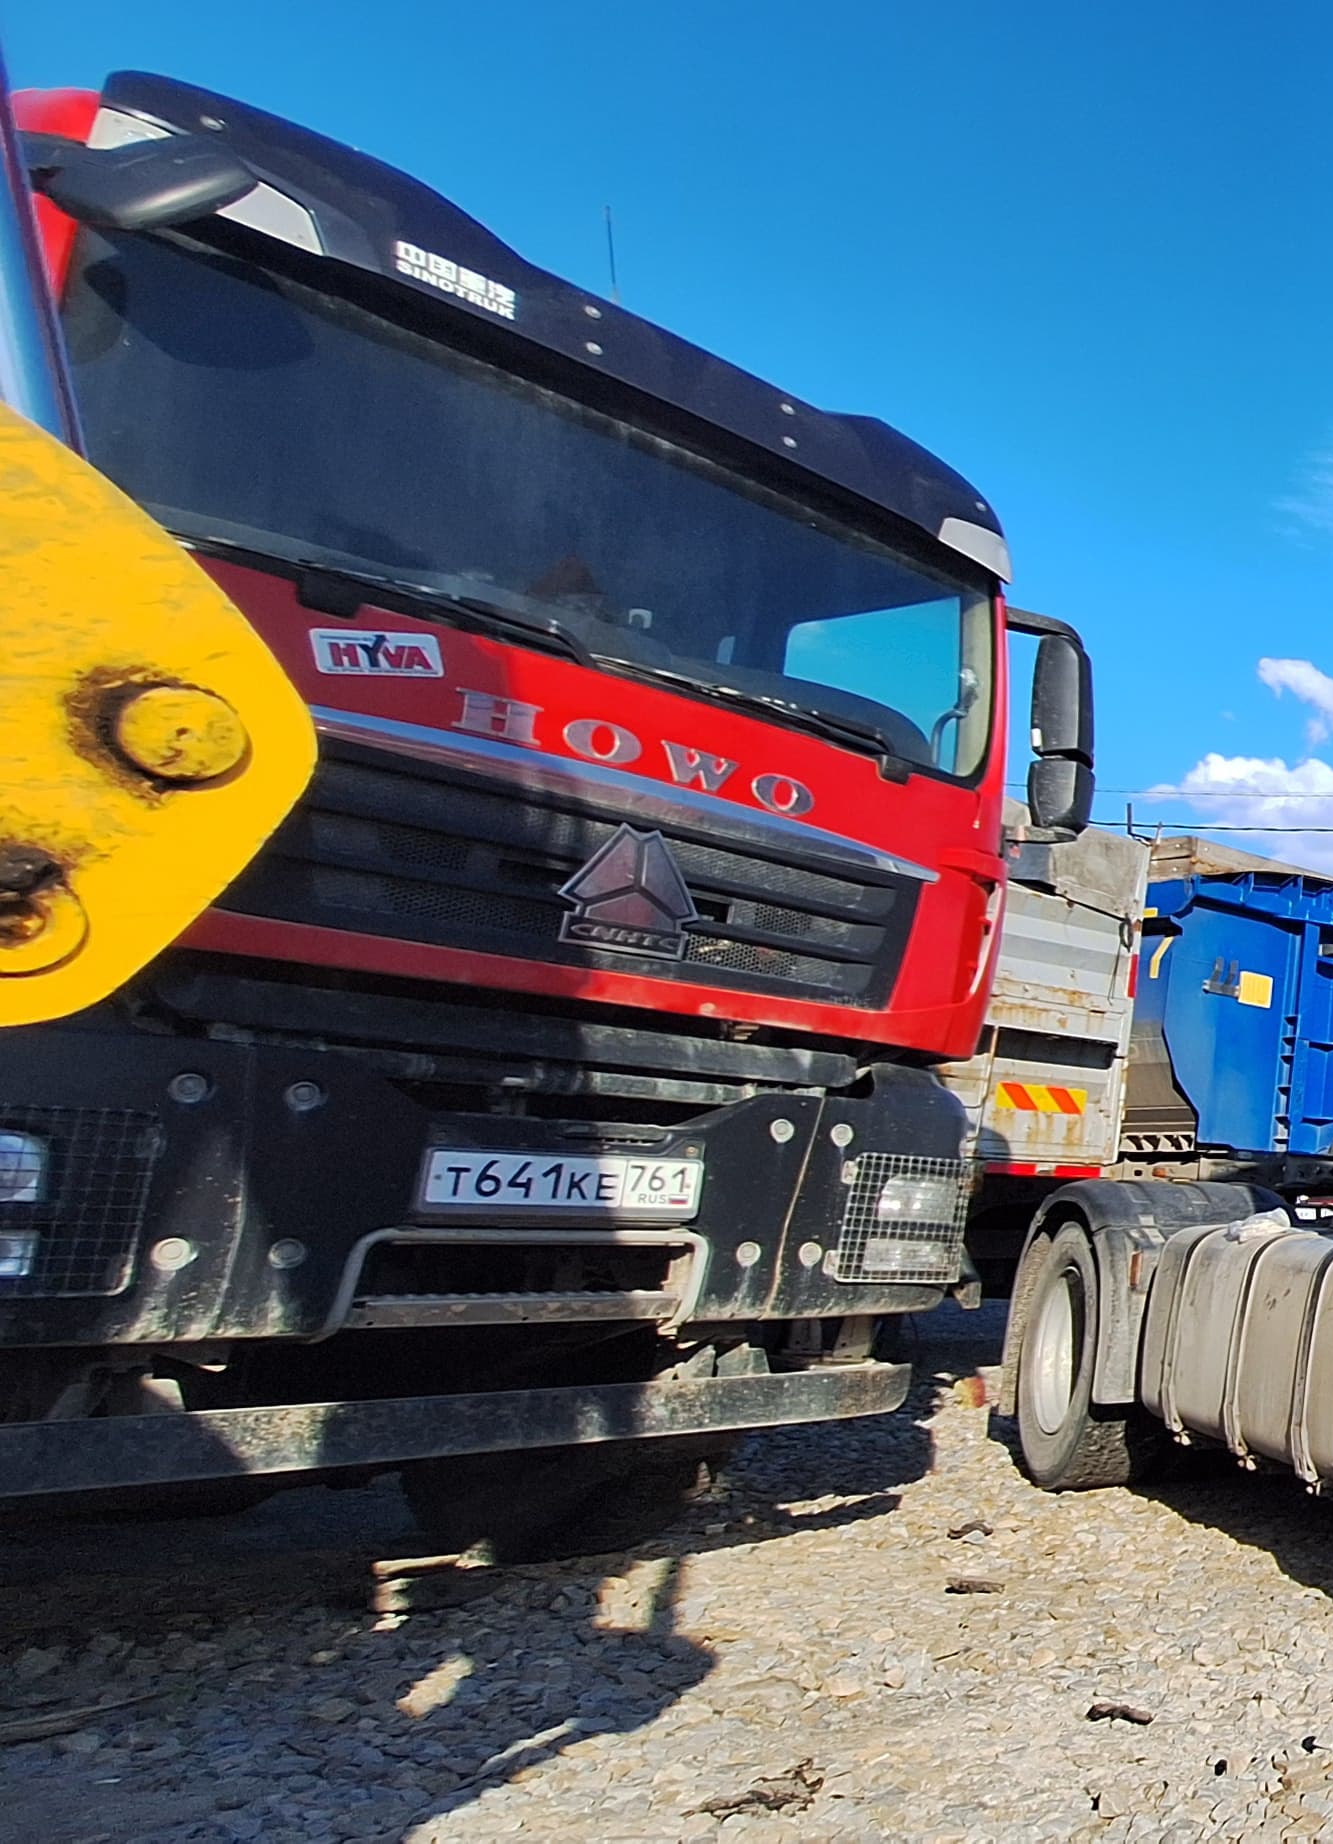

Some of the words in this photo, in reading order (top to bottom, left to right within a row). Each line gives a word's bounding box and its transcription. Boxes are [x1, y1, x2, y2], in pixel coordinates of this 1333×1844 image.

[396, 259, 516, 320] SINOTRUK
[327, 634, 433, 669] HYVA
[450, 687, 815, 816] HOWO
[570, 923, 677, 950] CNHTC
[630, 1164, 688, 1193] 761
[638, 1194, 667, 1205] RUS
